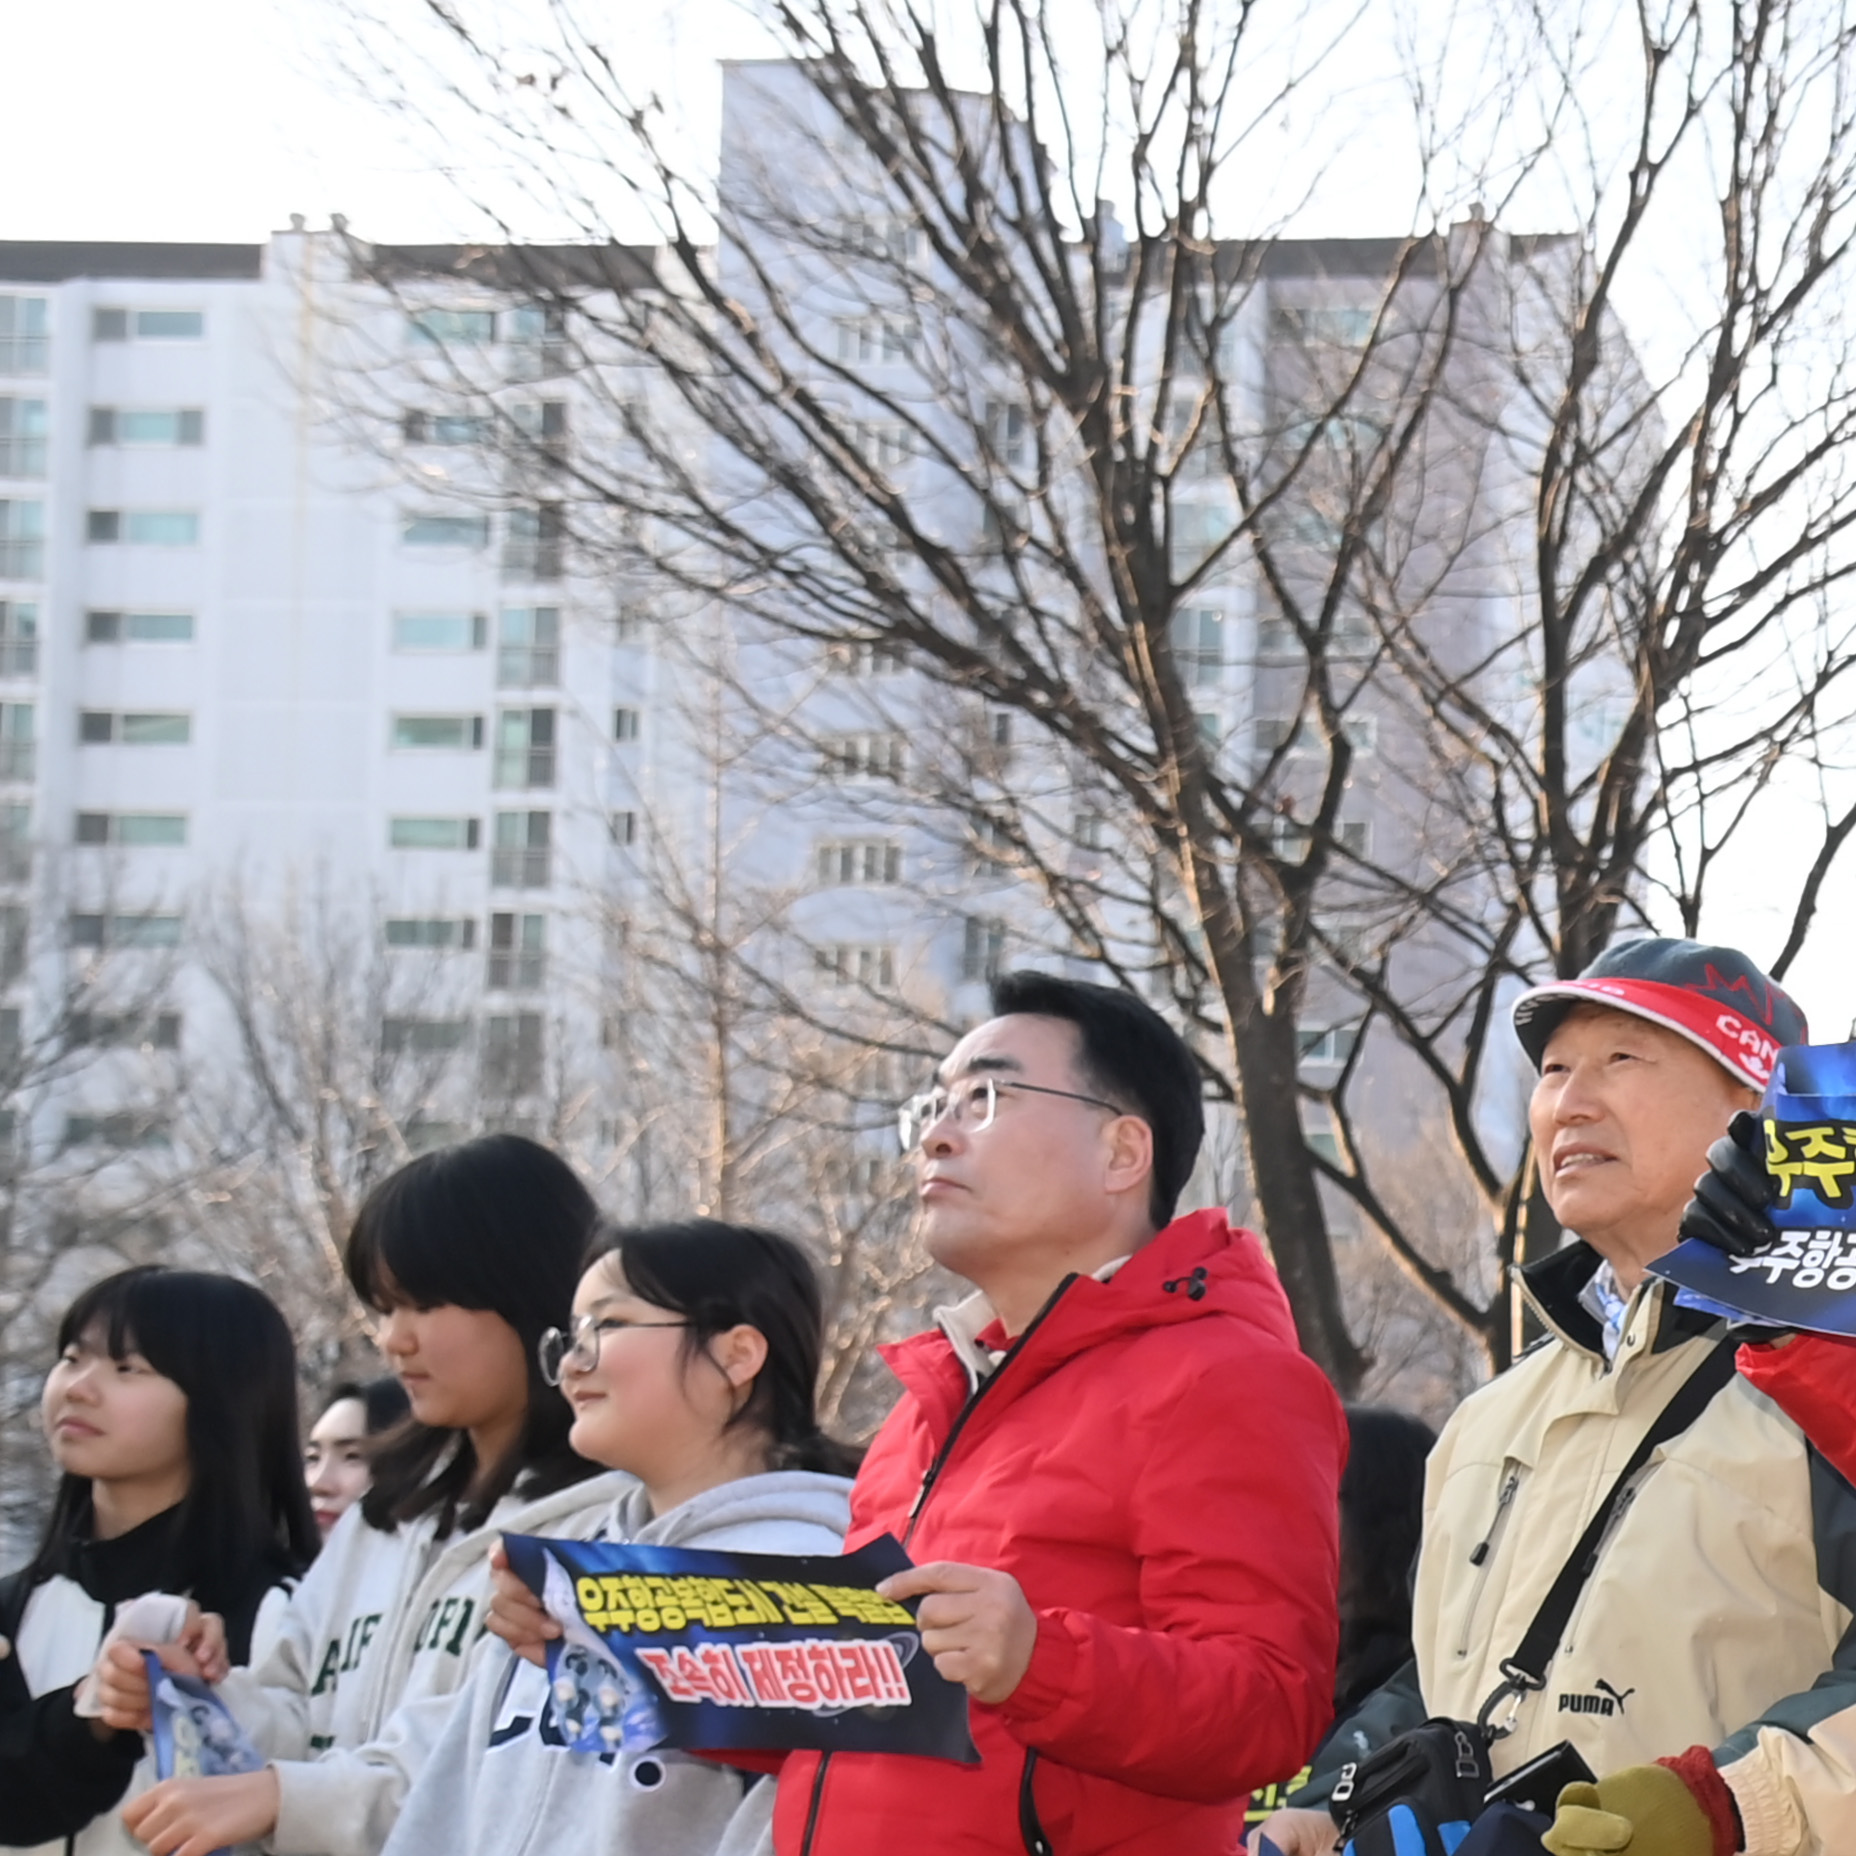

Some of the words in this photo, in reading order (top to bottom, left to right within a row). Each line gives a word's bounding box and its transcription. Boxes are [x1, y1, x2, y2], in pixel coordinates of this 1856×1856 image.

[771, 1581, 837, 1626] 건설
[640, 1649, 751, 1703] 조속히
[740, 1642, 909, 1704] 제정하라!!
[1558, 1693, 1614, 1716] PUMA
